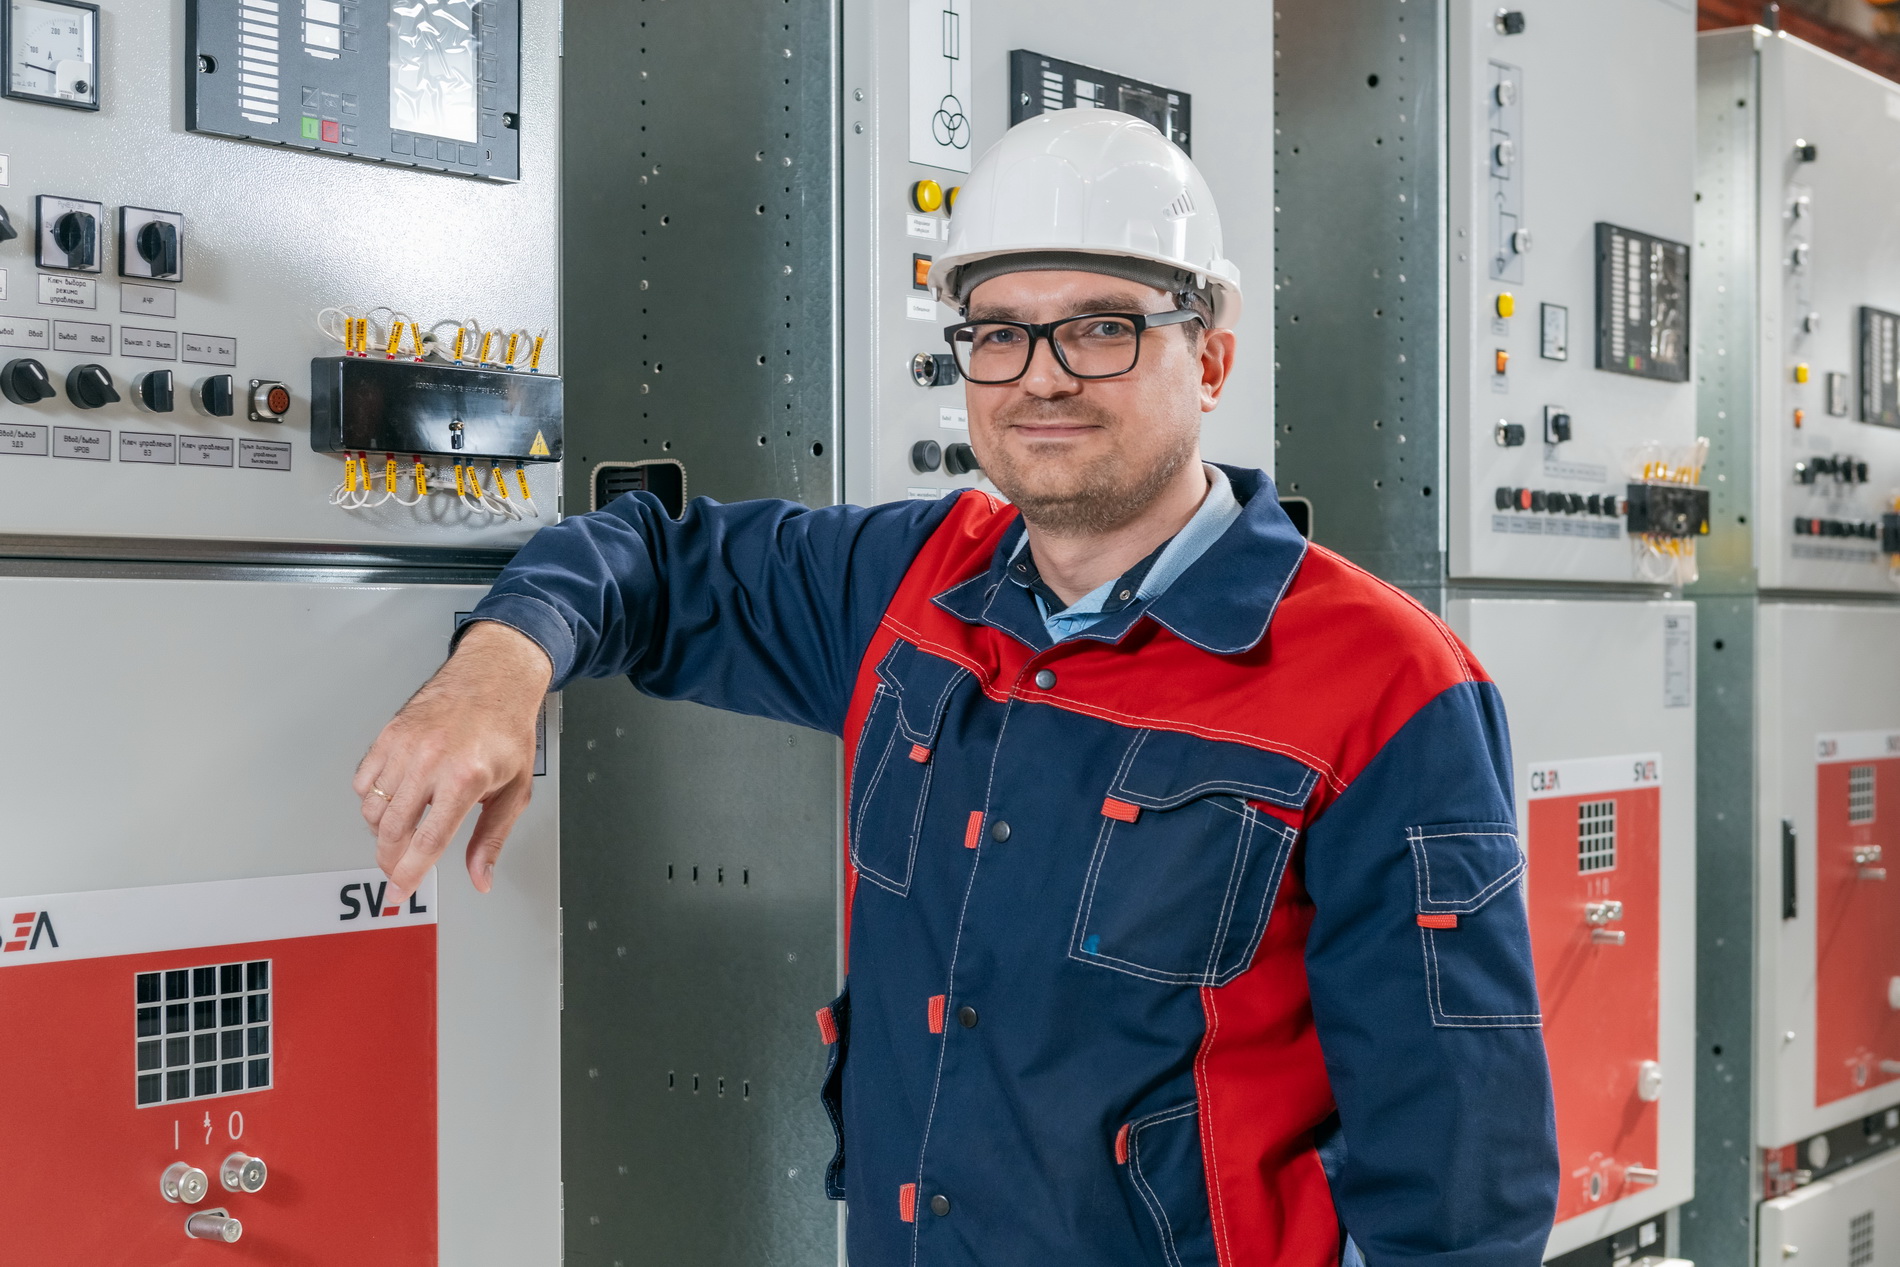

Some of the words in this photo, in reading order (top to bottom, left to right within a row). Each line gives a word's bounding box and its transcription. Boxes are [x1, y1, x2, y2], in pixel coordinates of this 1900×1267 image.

[51, 27, 60, 35] 200
[68, 27, 78, 35] 300
[47, 51, 53, 61] A
[65, 278, 87, 287] выбора
[50, 296, 84, 304] управления
[58, 332, 77, 340] Вывод
[63, 434, 100, 444] Ввод/вывод
[198, 443, 230, 451] управления
[340, 881, 427, 921] SVL
